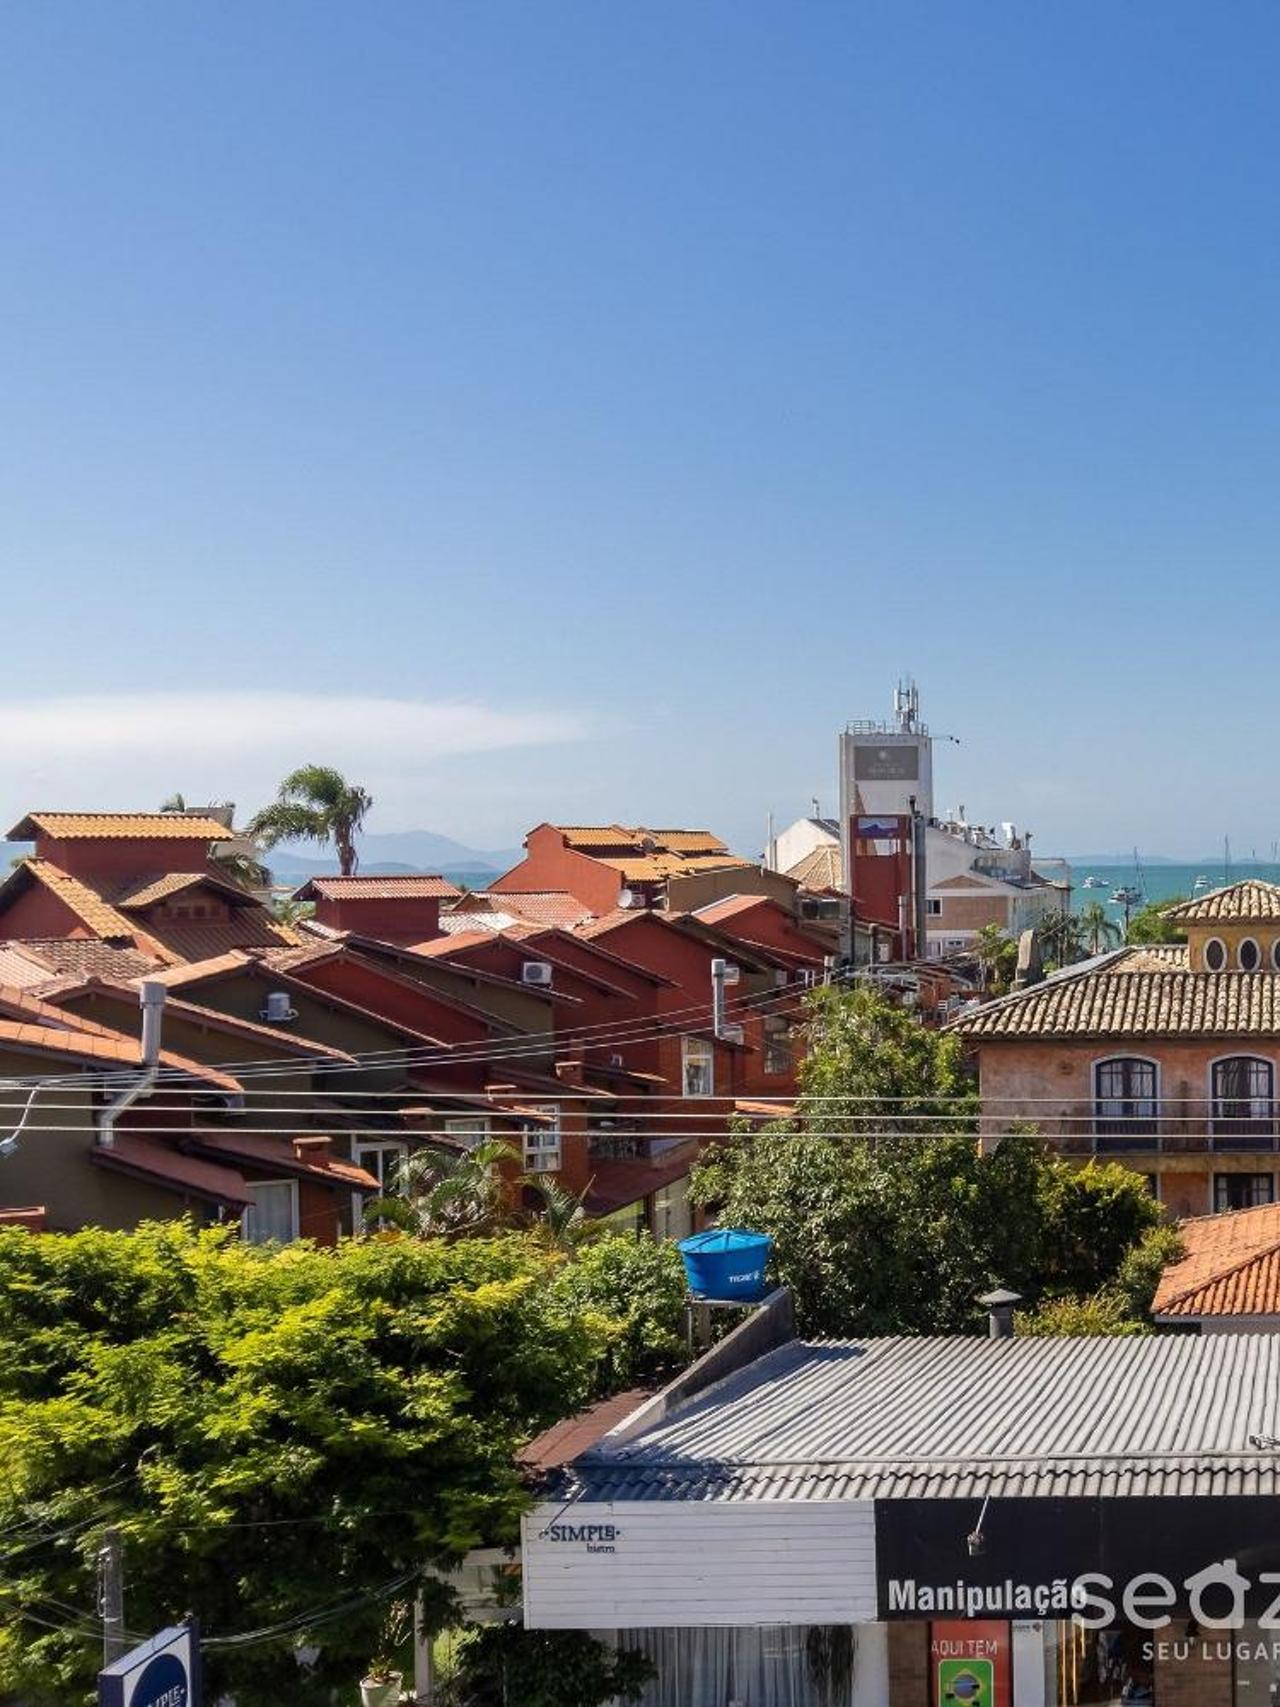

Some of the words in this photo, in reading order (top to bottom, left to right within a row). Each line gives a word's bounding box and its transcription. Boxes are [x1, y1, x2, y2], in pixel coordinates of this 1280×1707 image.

[550, 1525, 616, 1541] SIMPLE
[888, 1579, 1087, 1617] Manipulação
[931, 1639, 964, 1656] AQUI
[966, 1639, 998, 1656] TEM
